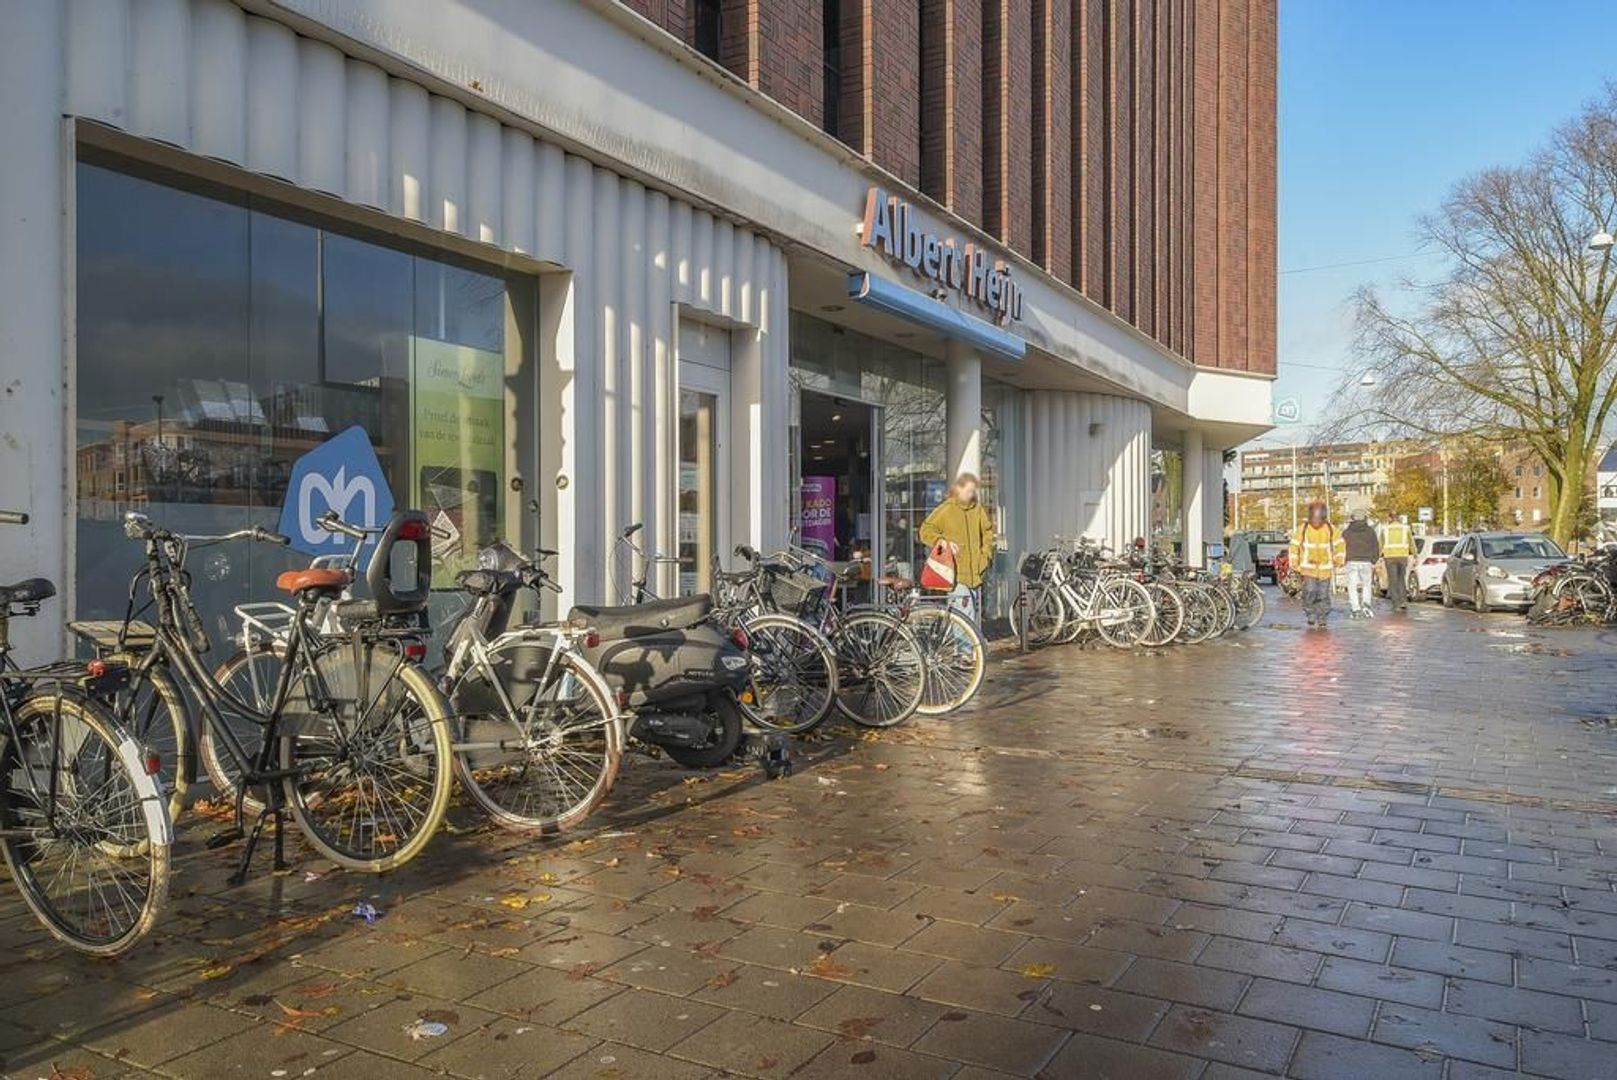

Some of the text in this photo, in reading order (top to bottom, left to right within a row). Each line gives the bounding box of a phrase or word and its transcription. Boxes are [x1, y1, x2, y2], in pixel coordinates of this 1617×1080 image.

[862, 187, 1023, 327] Albert Heijn
[801, 508, 818, 519] OR
